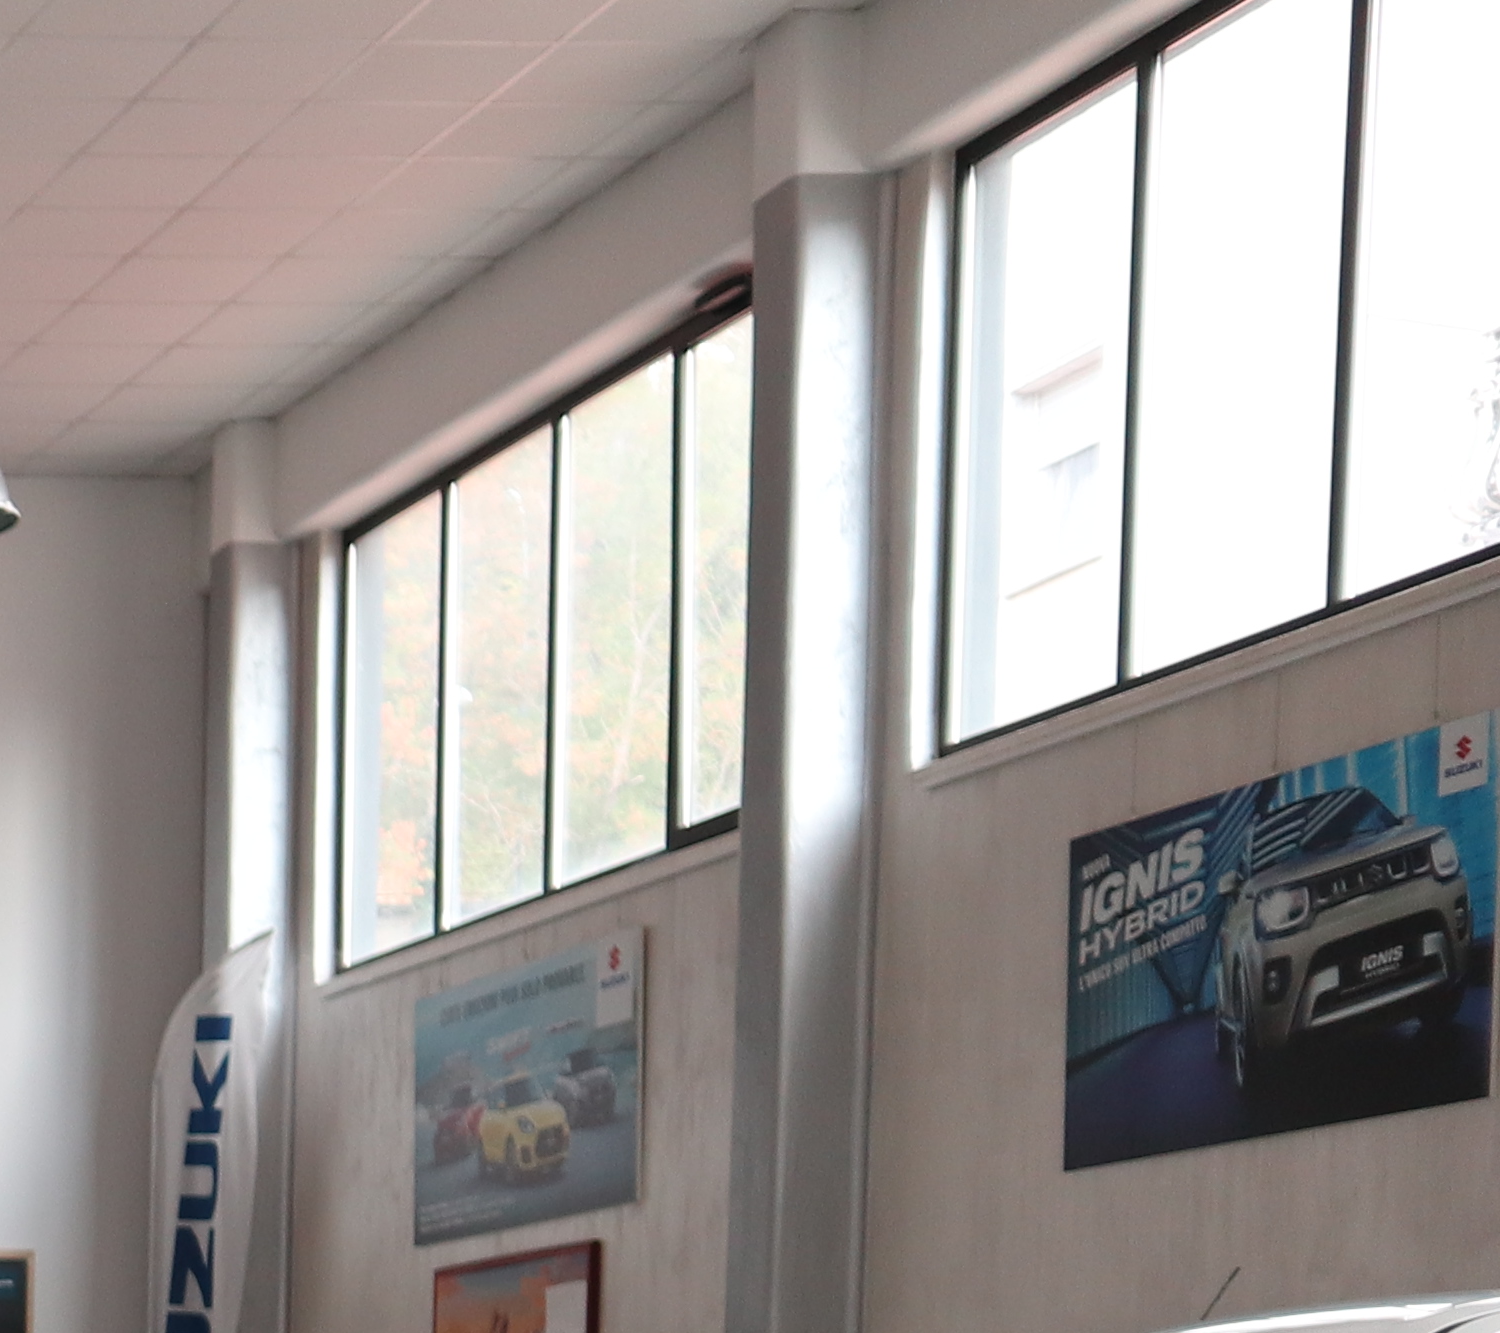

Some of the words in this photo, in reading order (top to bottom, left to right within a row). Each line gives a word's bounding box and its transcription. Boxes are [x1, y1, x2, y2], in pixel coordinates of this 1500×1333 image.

[1443, 758, 1484, 779] SUZUKI
[1079, 827, 1205, 933] IGNIS
[1078, 880, 1206, 966] HYBRID
[1360, 944, 1405, 972] IGNIS
